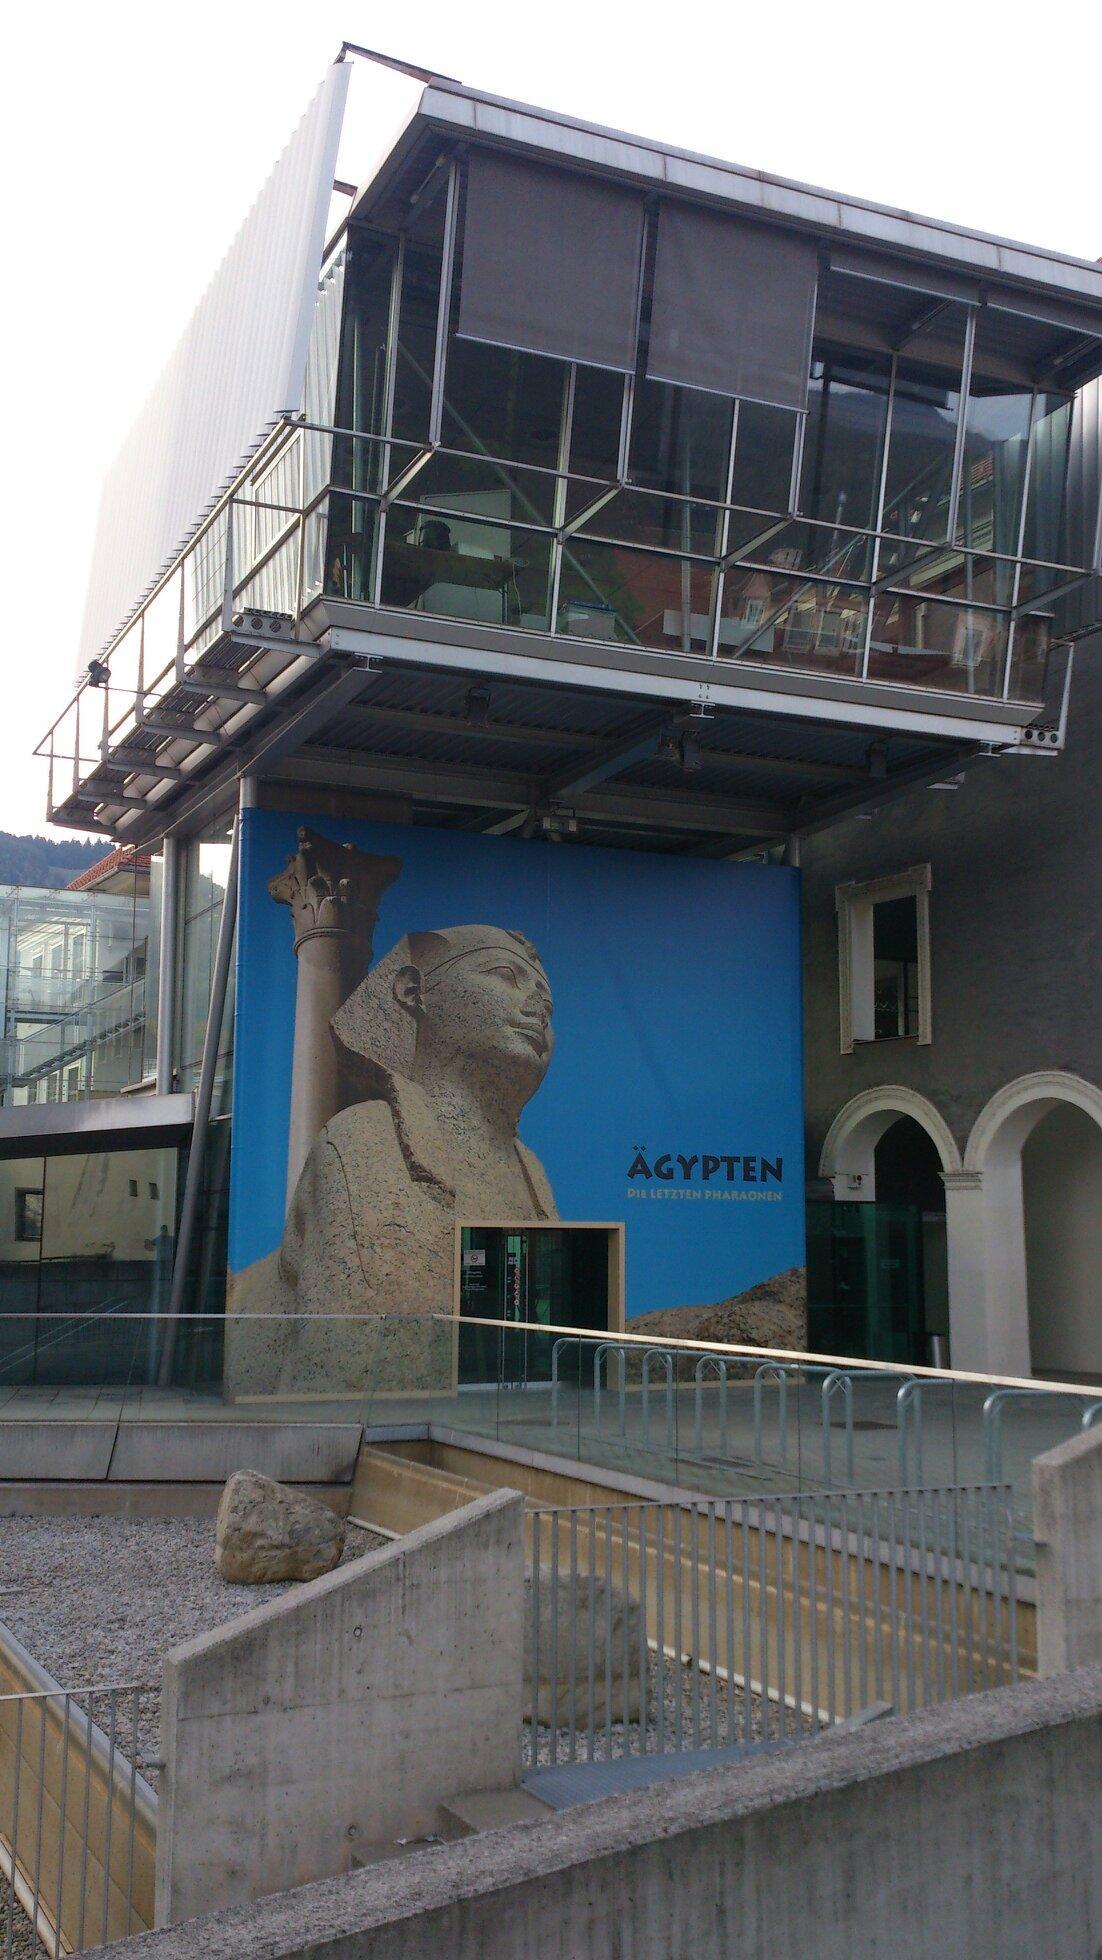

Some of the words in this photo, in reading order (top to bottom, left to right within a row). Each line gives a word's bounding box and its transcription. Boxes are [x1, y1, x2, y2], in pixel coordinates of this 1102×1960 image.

[627, 1145, 783, 1183] ÄGYPTEN
[650, 1189, 702, 1200] LETZTEN
[704, 1190, 783, 1202] PHARAONEN
